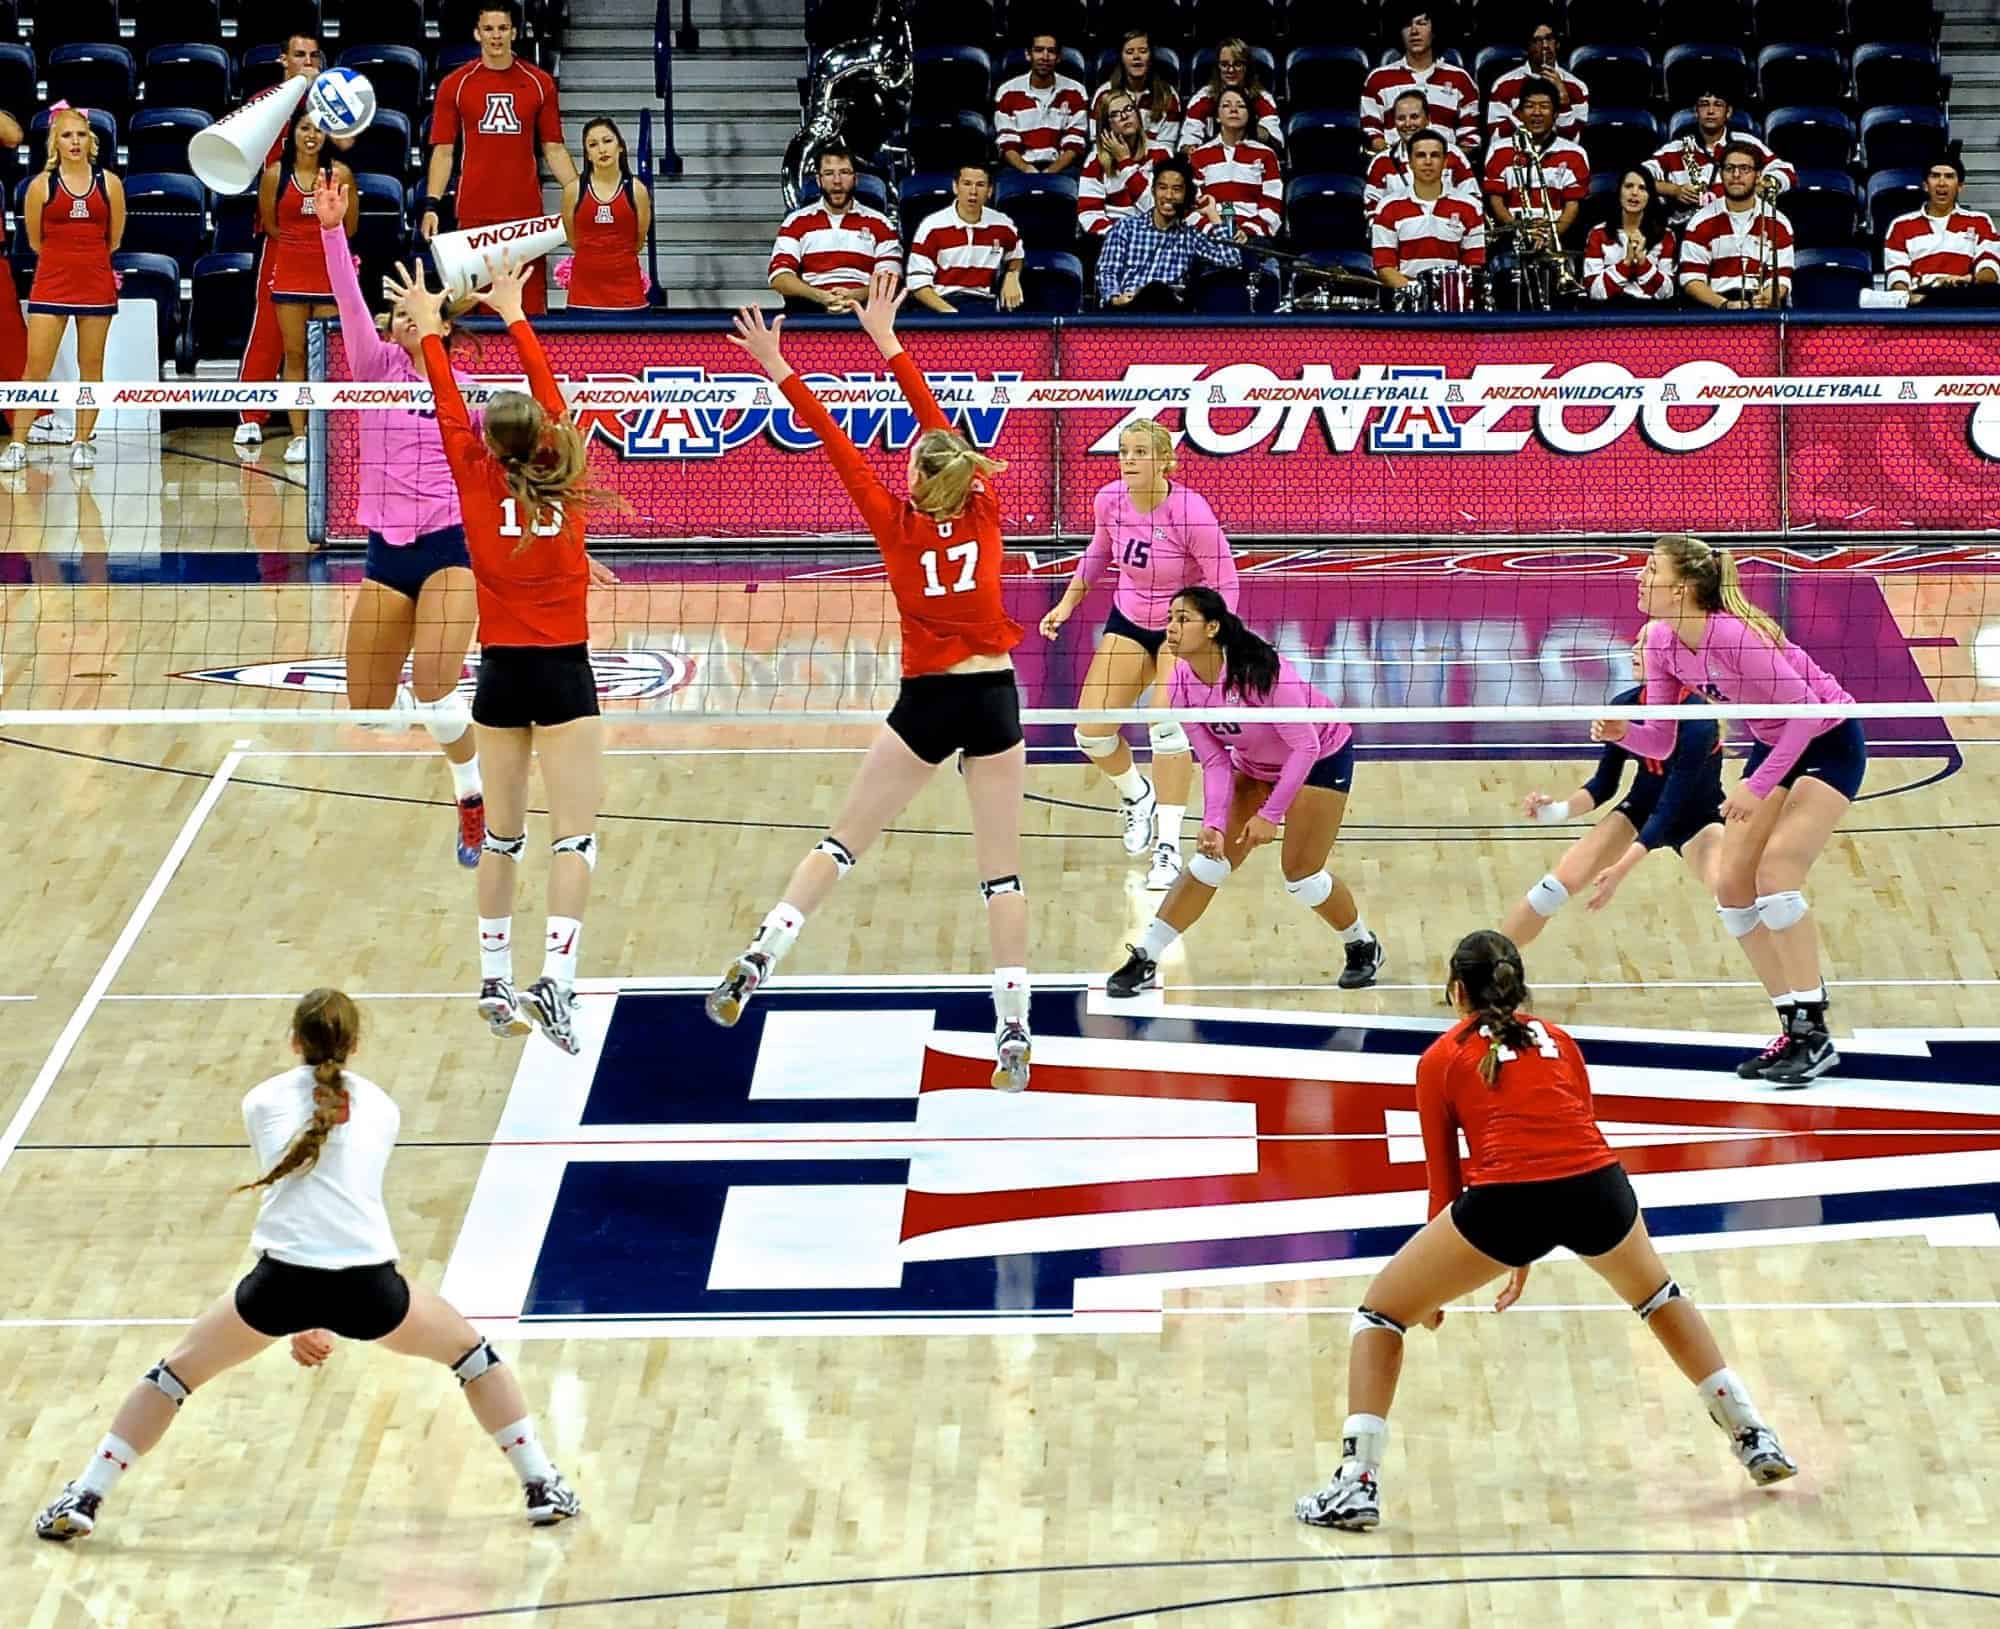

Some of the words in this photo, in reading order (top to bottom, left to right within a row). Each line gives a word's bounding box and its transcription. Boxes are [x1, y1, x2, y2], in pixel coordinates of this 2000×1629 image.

[478, 93, 521, 134] A
[467, 215, 561, 250] ARIZONA
[113, 389, 279, 403] ARIZONAWILDCATS
[572, 389, 737, 404] ARIZONAWILDCATS
[1027, 387, 1192, 402] ARIZONAWILDCATS
[1243, 386, 1429, 401] ARIZONAVOLLEYBALL
[1481, 385, 1644, 400] ARIZONAWILDCATS
[1696, 383, 1883, 399] ARIZONAVOLLEYBALL
[920, 541, 979, 597] 17
[1123, 538, 1152, 568] 15
